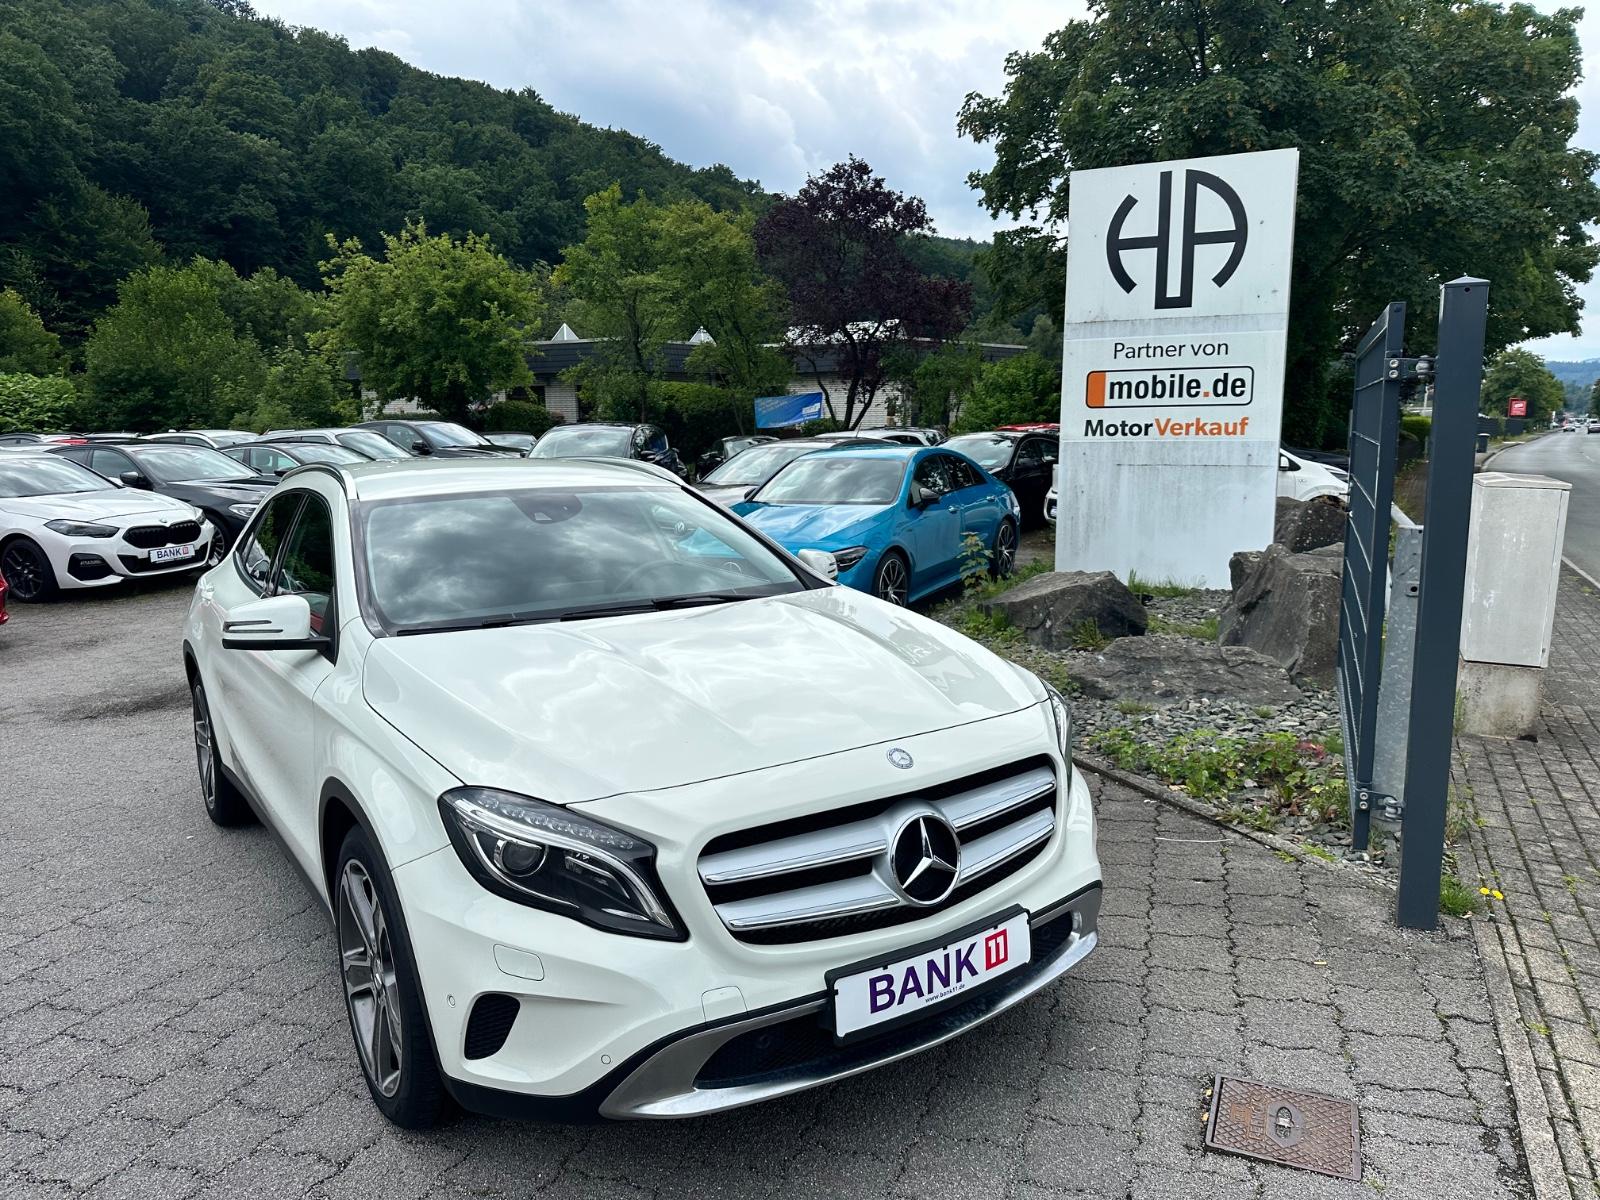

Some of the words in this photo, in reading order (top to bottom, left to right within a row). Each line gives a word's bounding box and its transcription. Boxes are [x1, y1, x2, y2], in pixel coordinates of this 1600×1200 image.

[1113, 342, 1186, 359] Partner
[1191, 342, 1229, 357] von
[1109, 372, 1246, 400] mobile.de
[156, 548, 181, 559] BANK
[868, 941, 979, 1014] BANK
[987, 932, 1006, 967] 11
